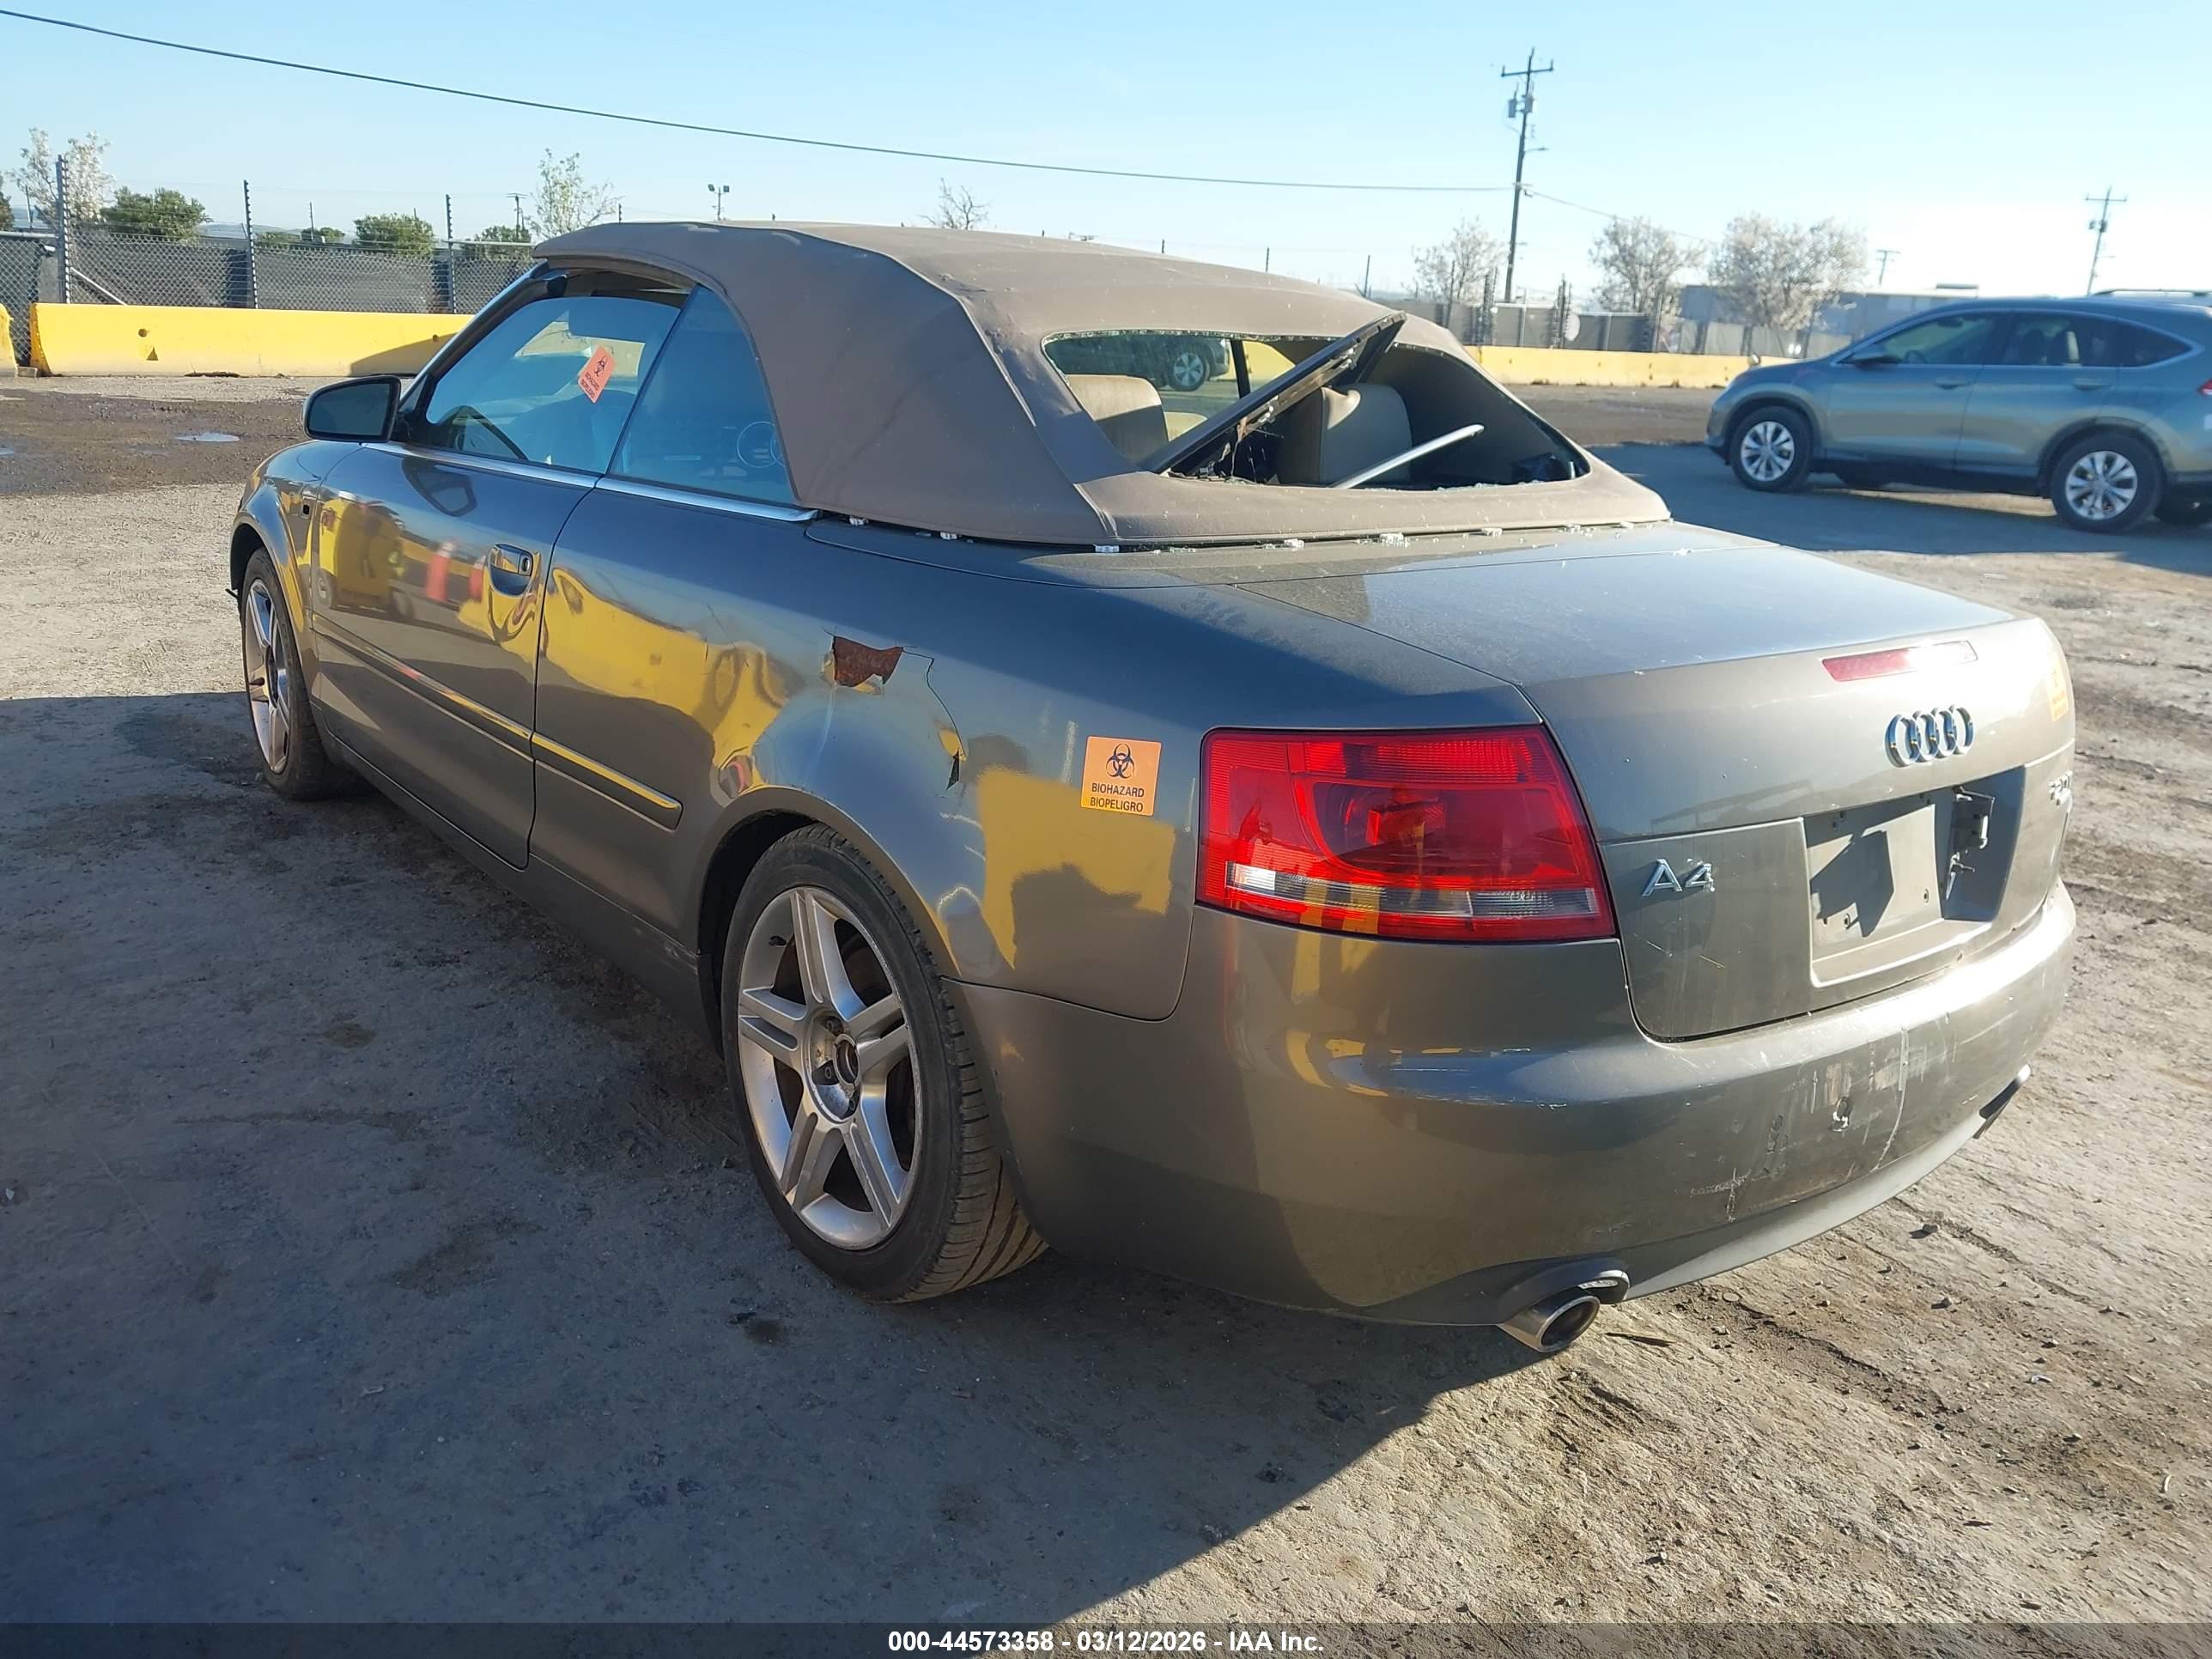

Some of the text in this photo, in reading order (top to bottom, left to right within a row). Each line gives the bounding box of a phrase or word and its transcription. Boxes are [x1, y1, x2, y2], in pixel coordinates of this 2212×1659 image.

[1091, 782, 1145, 798] BIOHAZARD
[1090, 797, 1144, 812] BIOPELIGRO
[1641, 859, 1716, 896] A4
